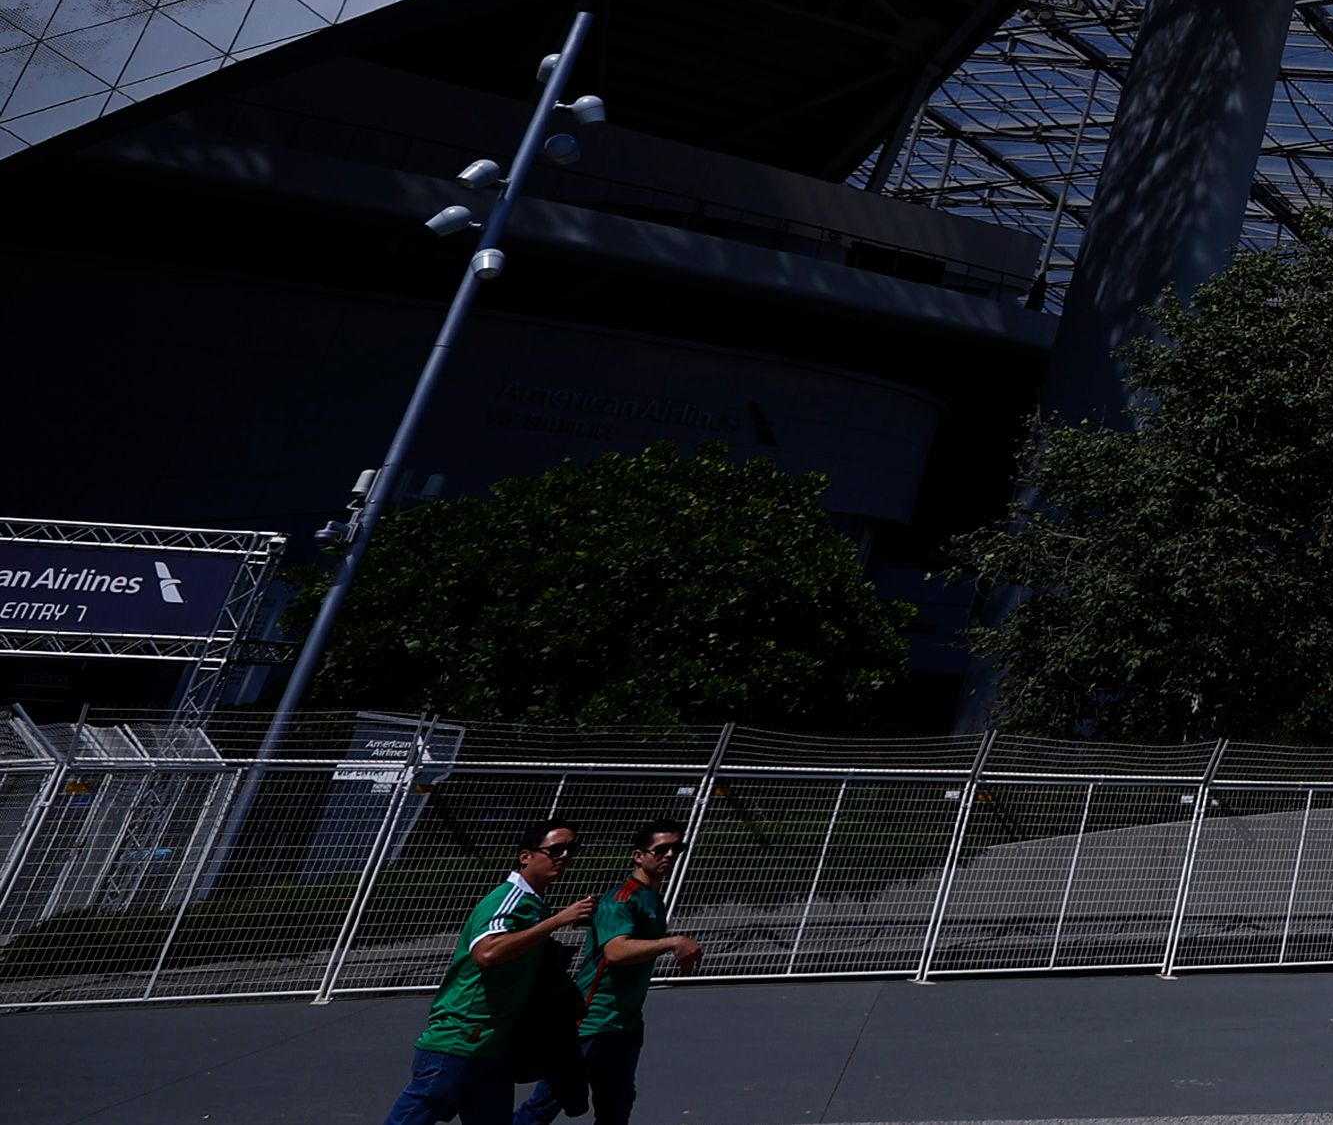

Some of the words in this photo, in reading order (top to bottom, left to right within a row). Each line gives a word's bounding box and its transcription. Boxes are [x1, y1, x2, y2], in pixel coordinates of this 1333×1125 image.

[31, 568, 143, 594] Airlines
[0, 602, 69, 621] ENTRY
[77, 605, 88, 622] 7
[365, 740, 411, 749] American
[371, 748, 408, 756] Airlines
